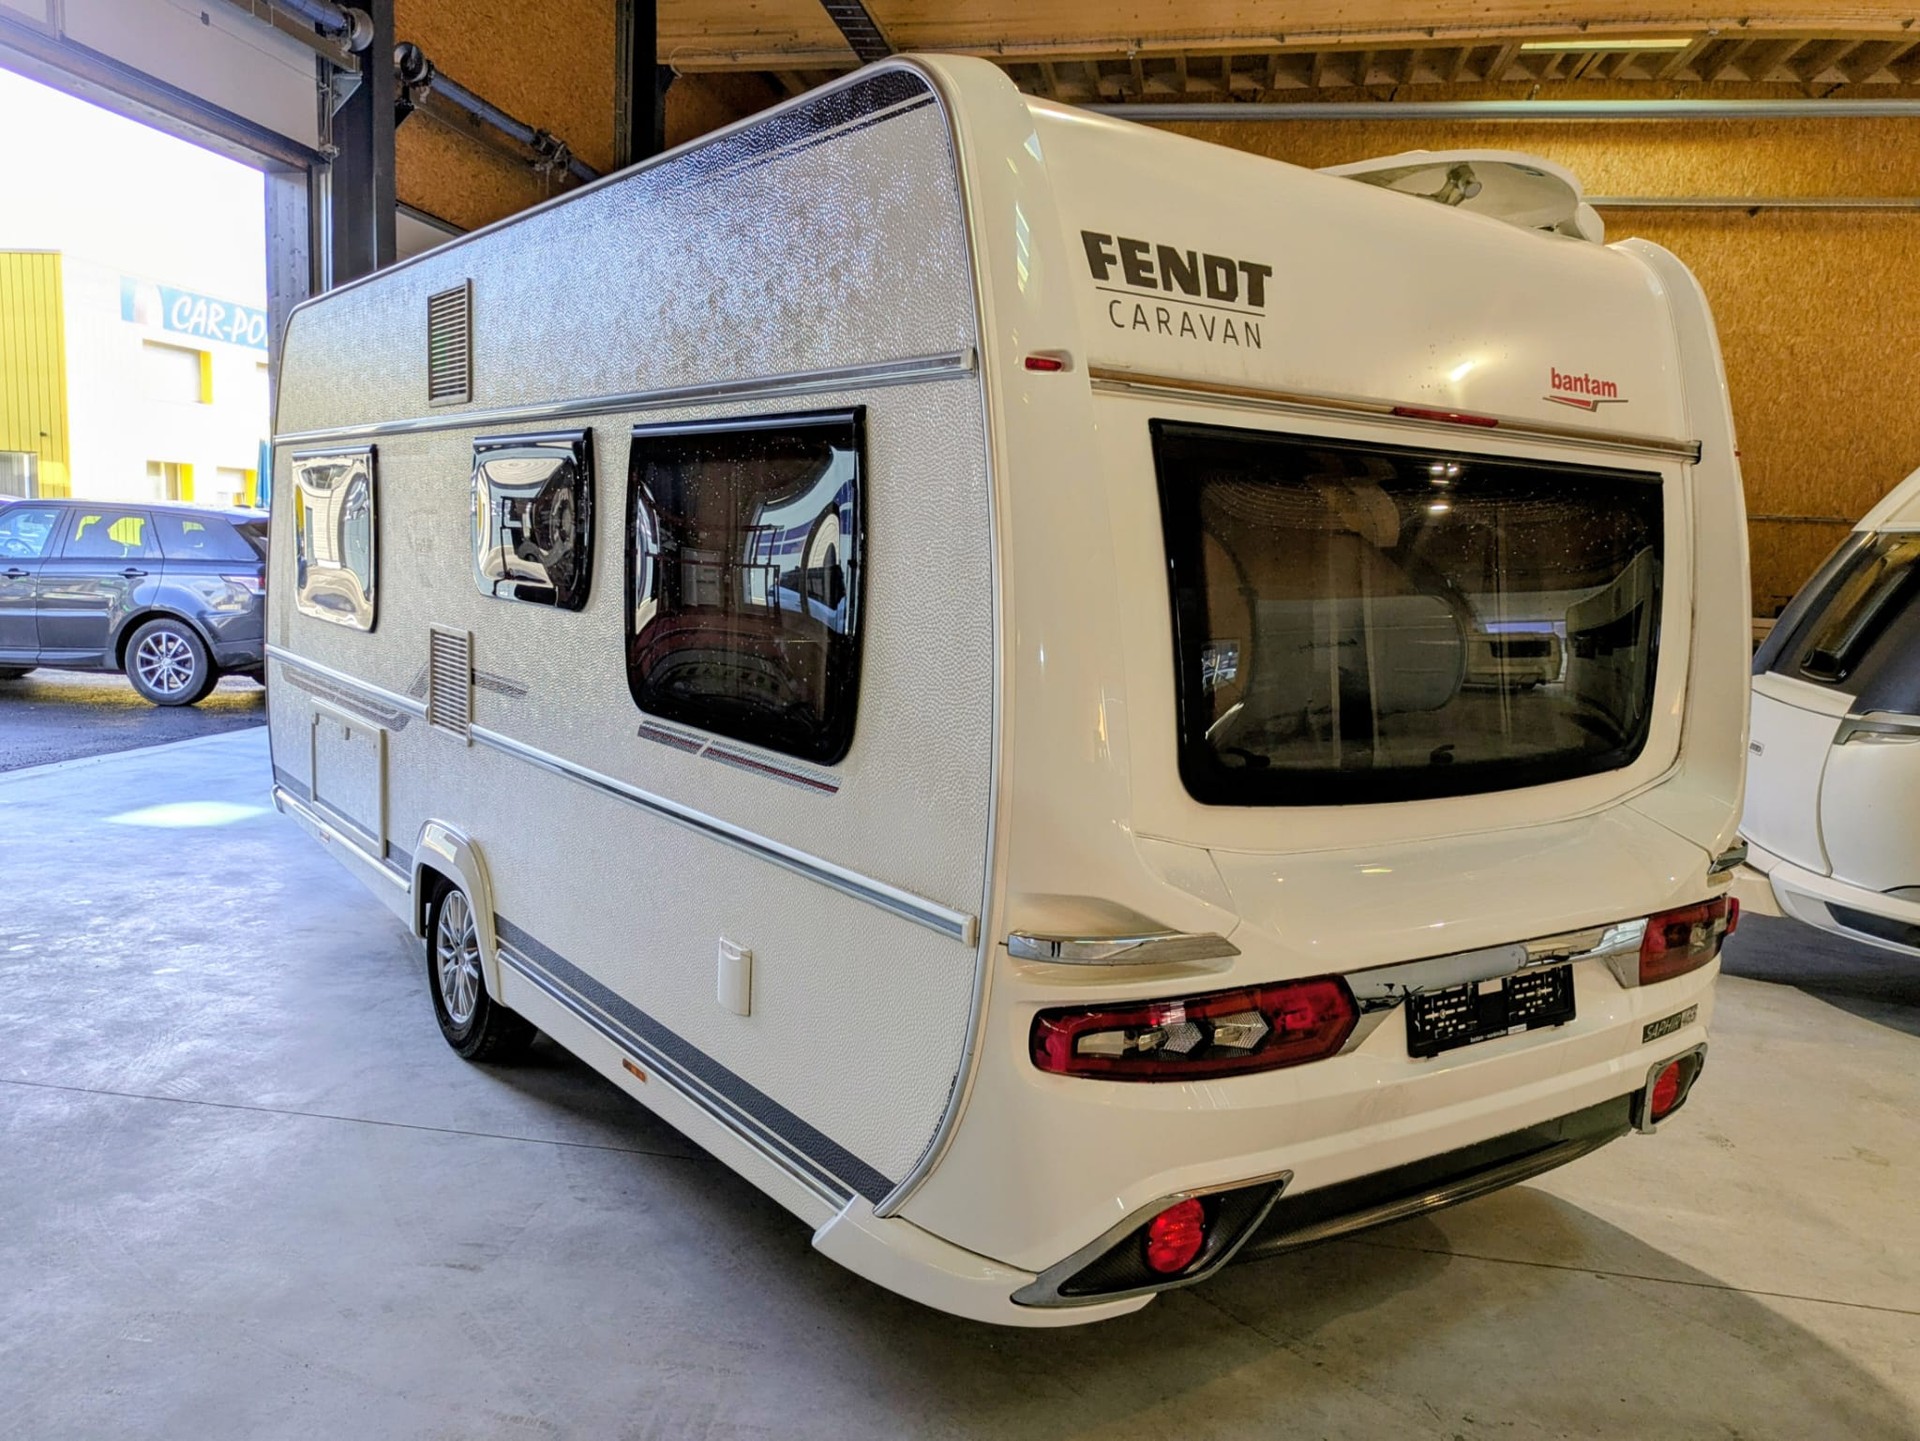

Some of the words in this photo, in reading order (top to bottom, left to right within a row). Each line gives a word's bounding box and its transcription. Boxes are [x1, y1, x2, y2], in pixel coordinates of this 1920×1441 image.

[1080, 230, 1273, 308] FENDT
[1109, 300, 1262, 349] CARAVAN
[1551, 367, 1617, 398] bantam
